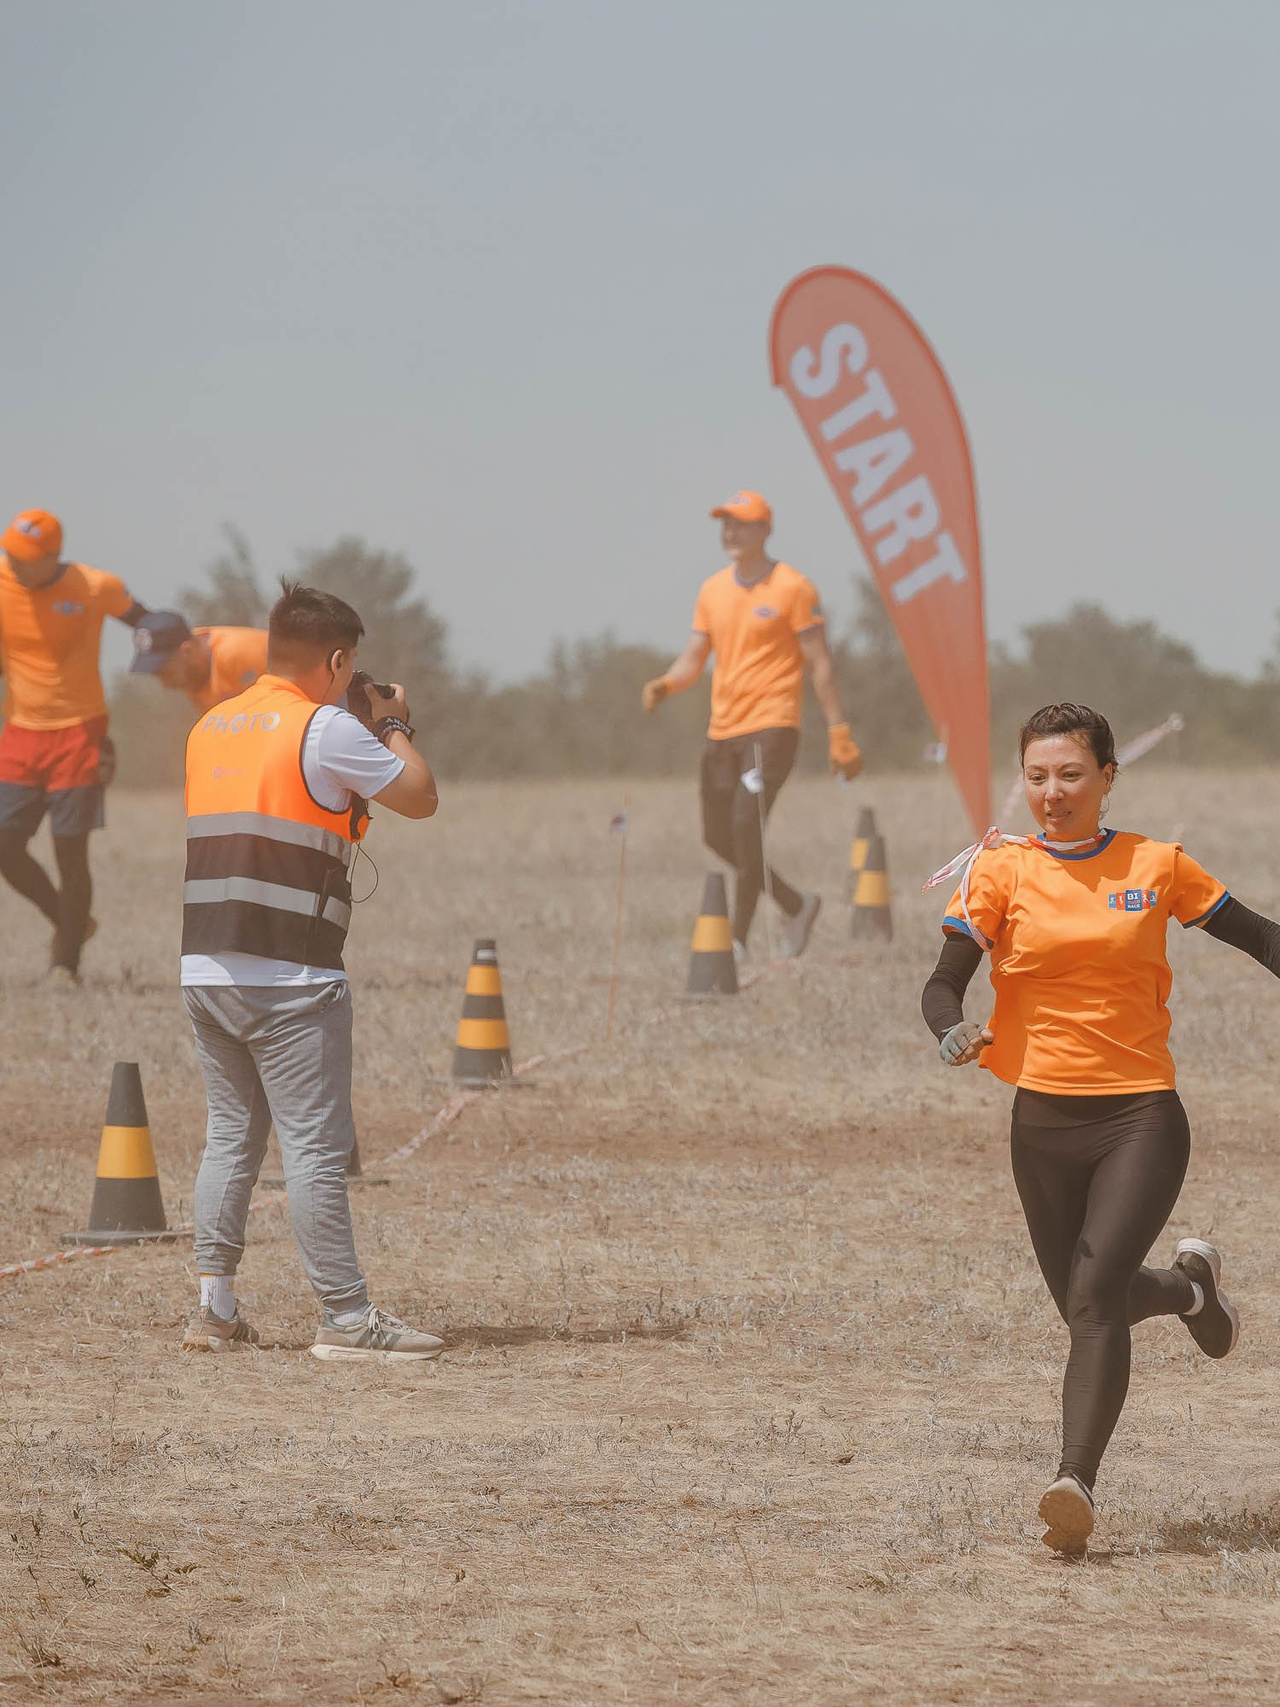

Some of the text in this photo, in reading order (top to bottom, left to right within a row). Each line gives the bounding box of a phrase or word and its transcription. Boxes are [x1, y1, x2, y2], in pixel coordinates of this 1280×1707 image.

[788, 323, 968, 603] START
[201, 711, 280, 733] PHOTO
[1127, 892, 1139, 900] BI
